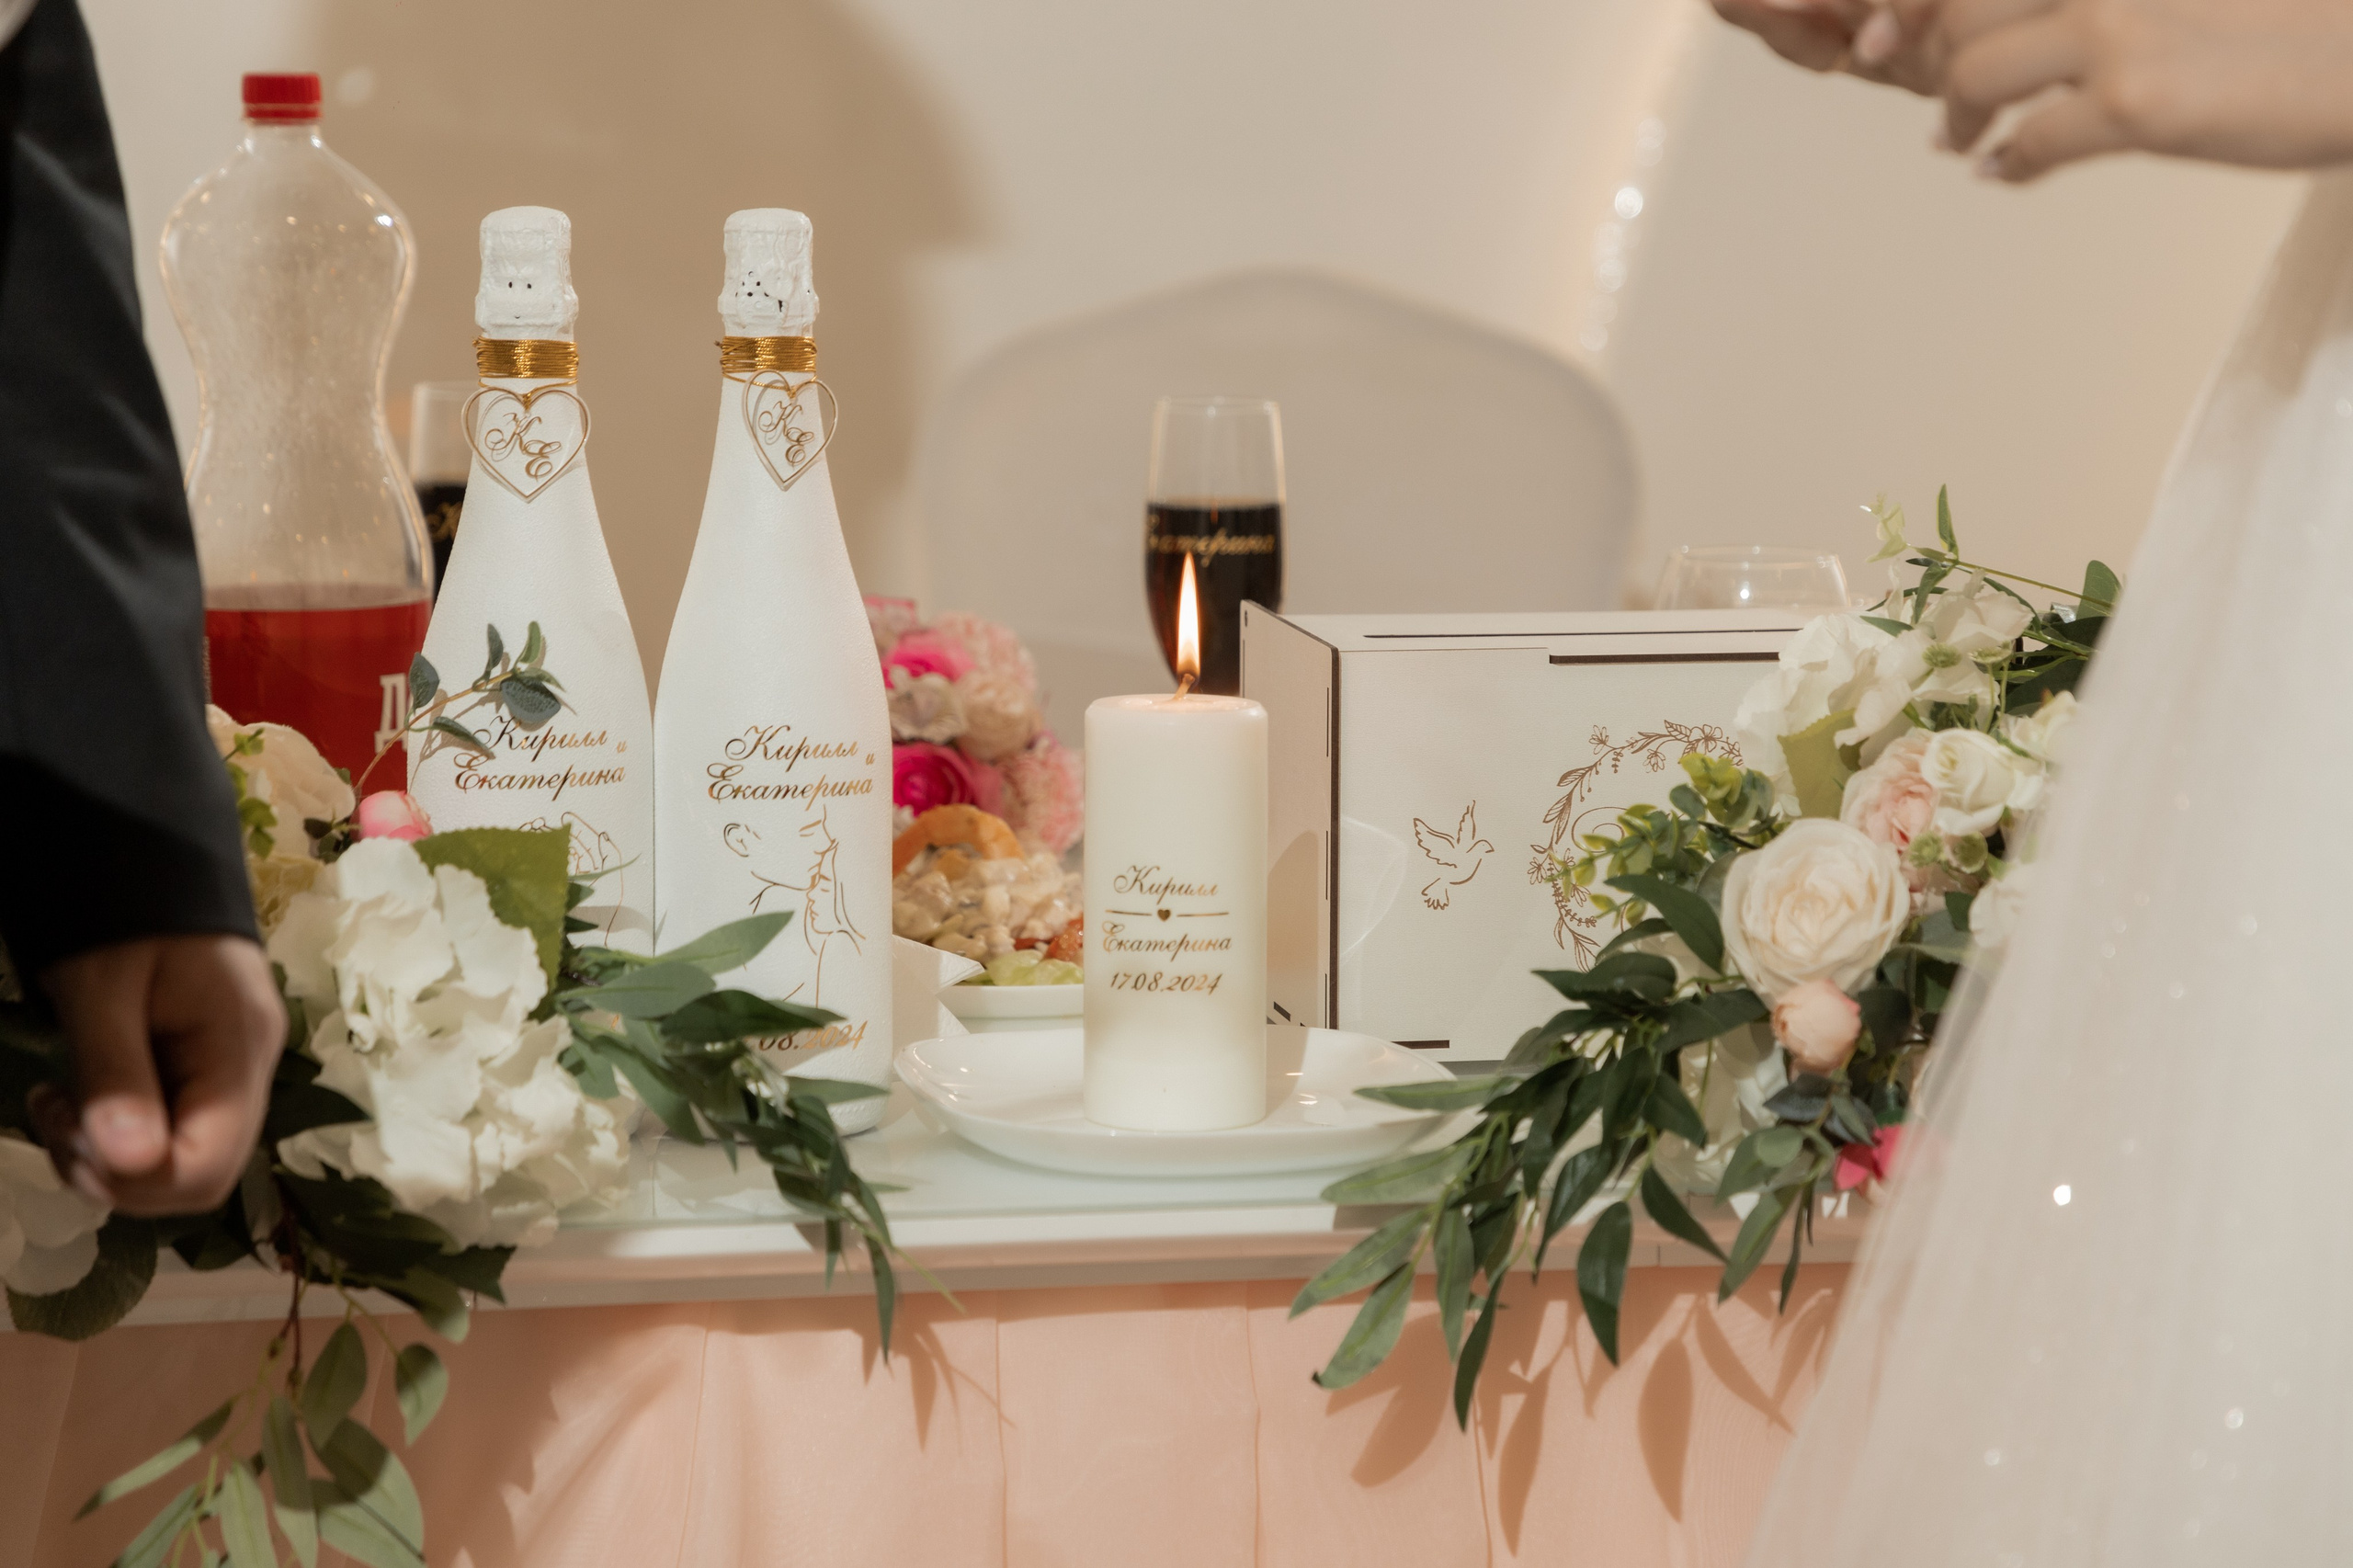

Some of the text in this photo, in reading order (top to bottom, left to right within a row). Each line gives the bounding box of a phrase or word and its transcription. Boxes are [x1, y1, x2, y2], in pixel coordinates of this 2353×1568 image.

[472, 715, 608, 763] Кирилл
[724, 724, 858, 773] Кирилл
[452, 752, 627, 801] Екатерина
[706, 762, 874, 812] Екатерина
[1112, 865, 1219, 905] Кирилл
[1101, 921, 1233, 963] Екатерина
